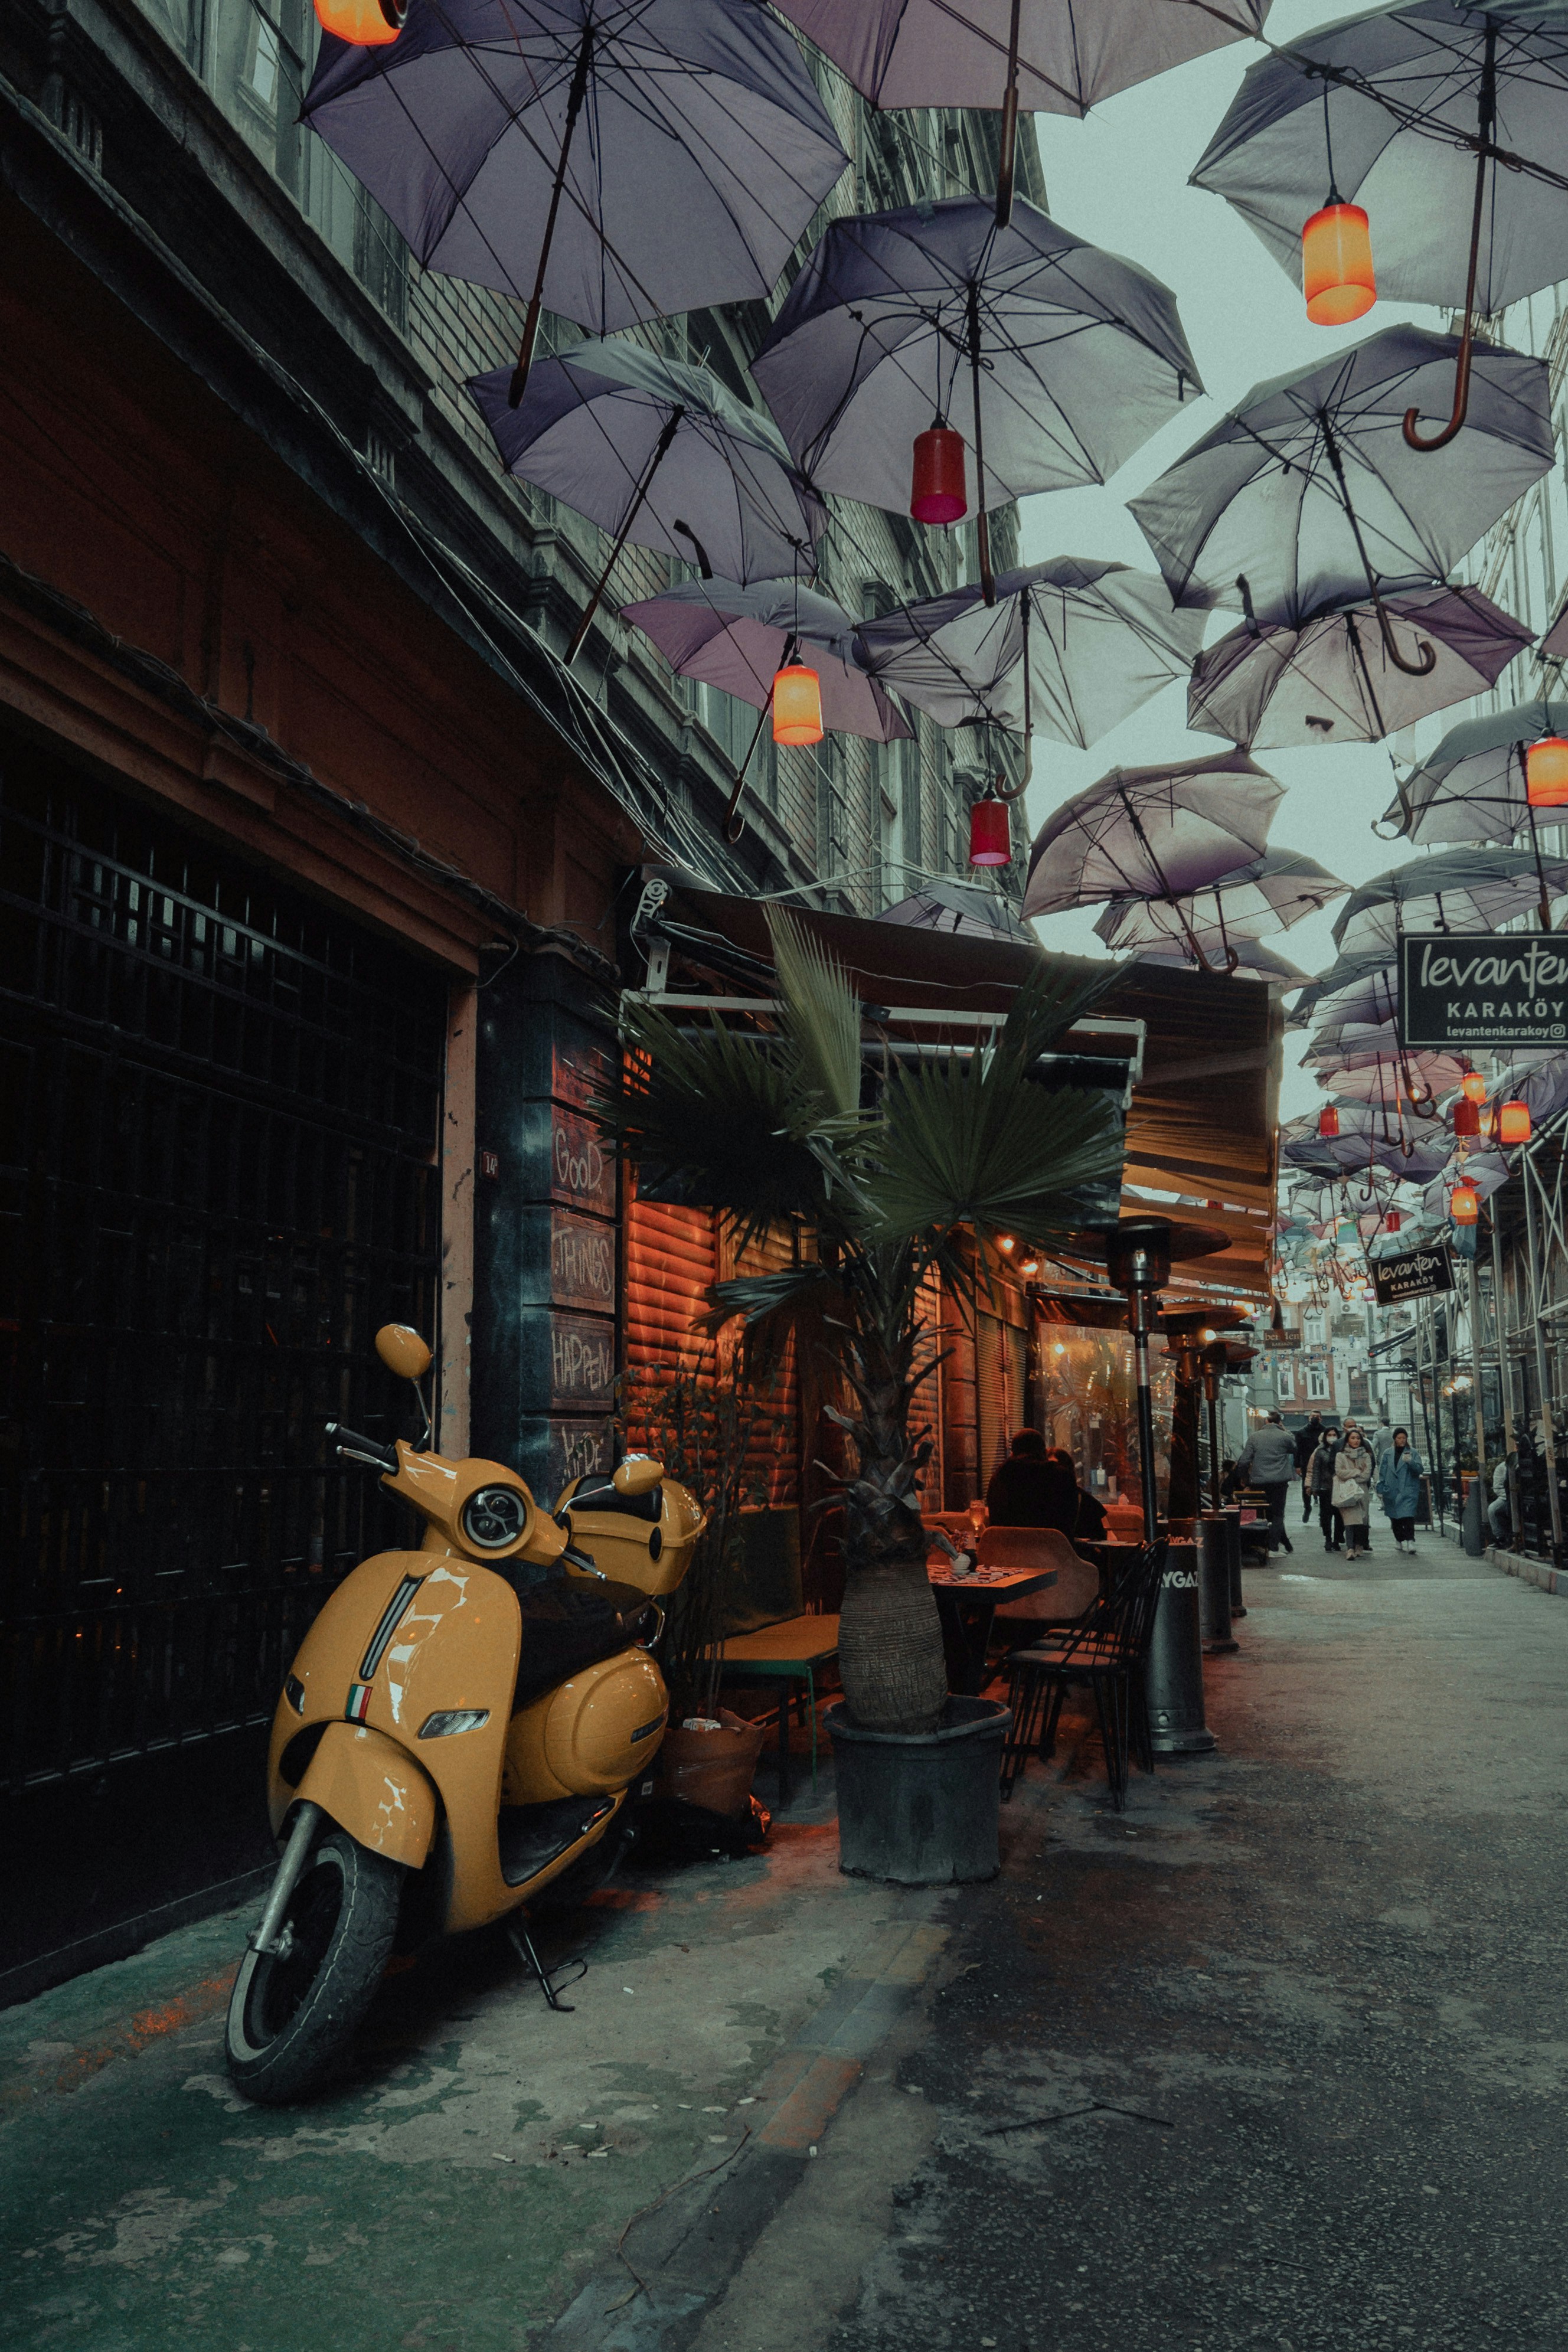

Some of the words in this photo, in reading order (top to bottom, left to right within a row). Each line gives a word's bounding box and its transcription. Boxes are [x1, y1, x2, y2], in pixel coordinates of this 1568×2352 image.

[1447, 998, 1564, 1018] KARAKÖY
[1446, 1025, 1550, 1038] levantenkarakoy
[1377, 1253, 1442, 1282] levanten
[1390, 1275, 1434, 1292] KARAKÖY
[551, 1331, 609, 1391] HAPPEN
